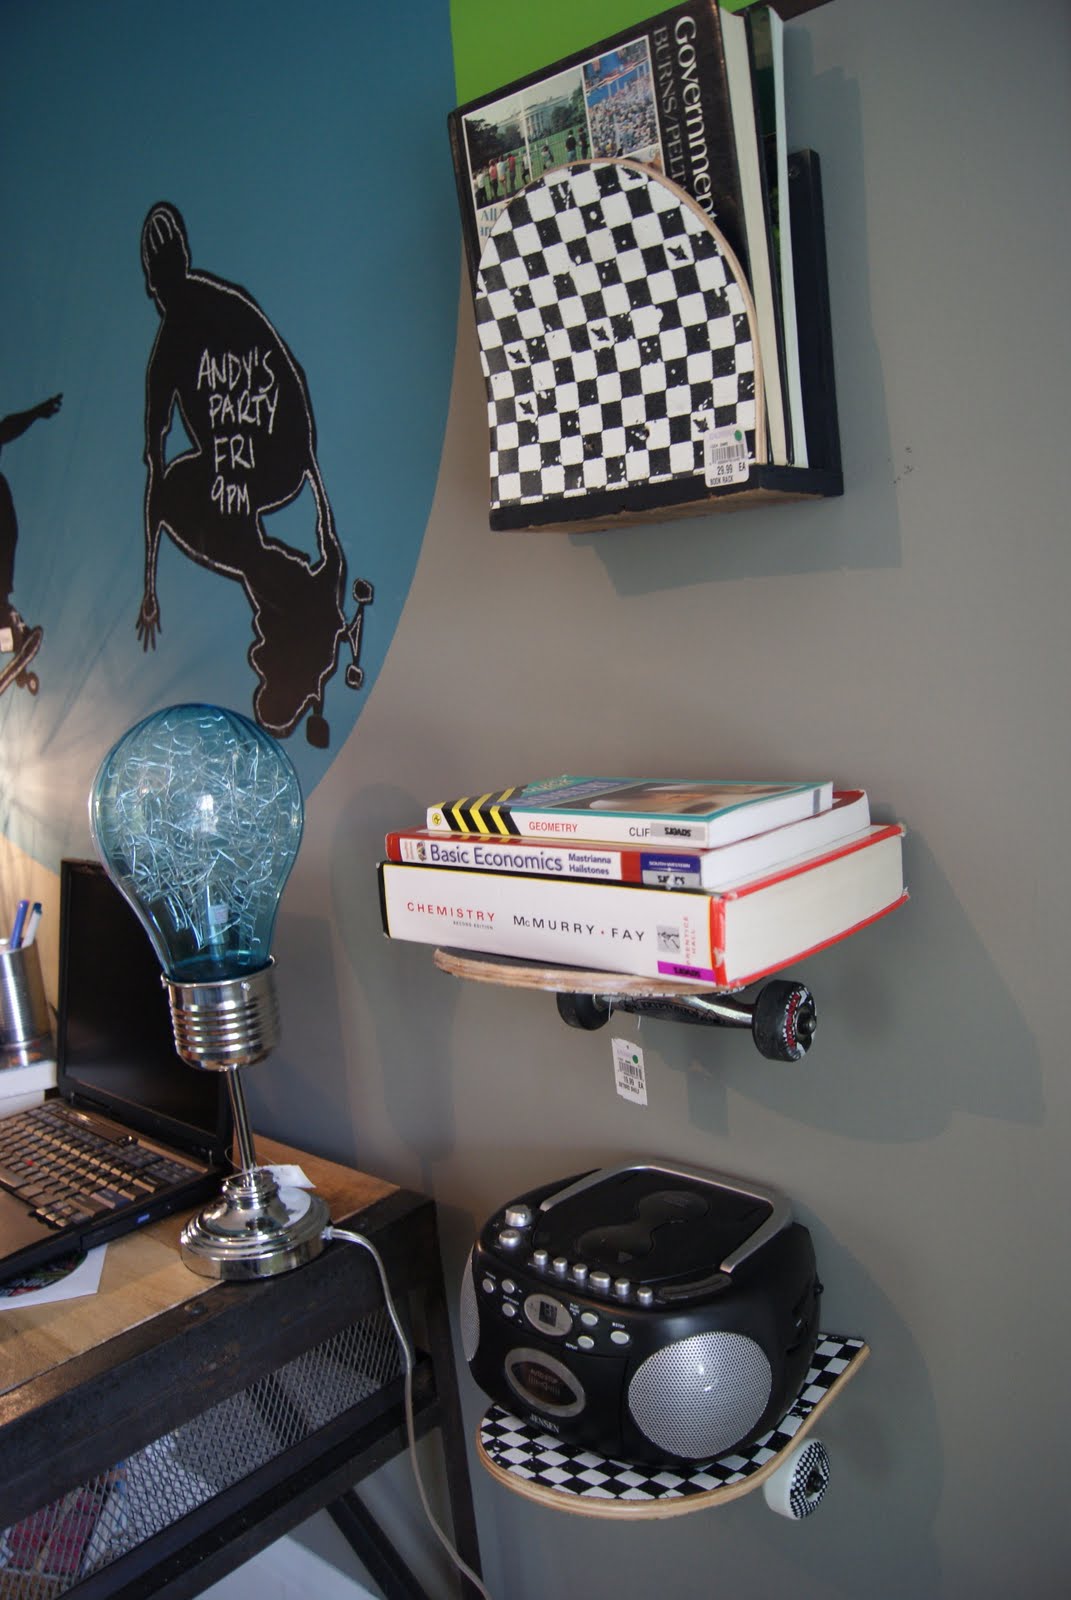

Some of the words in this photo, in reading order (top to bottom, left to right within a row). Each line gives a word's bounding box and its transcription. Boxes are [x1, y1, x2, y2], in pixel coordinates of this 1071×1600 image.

[653, 26, 688, 191] BURNS/PELT
[197, 346, 275, 393] ANDY'S
[209, 383, 280, 435] PARTY
[214, 433, 255, 473] FRI
[211, 475, 250, 516] 9PM
[529, 821, 578, 833] GEOMETRY
[628, 826, 650, 837] CLIF
[430, 843, 470, 864] Basic
[474, 846, 563, 872] Economics
[568, 853, 612, 865] Mastrianna
[569, 864, 609, 876] Hailstones
[407, 902, 495, 922] CHEMISTRY
[611, 928, 645, 941] FAY
